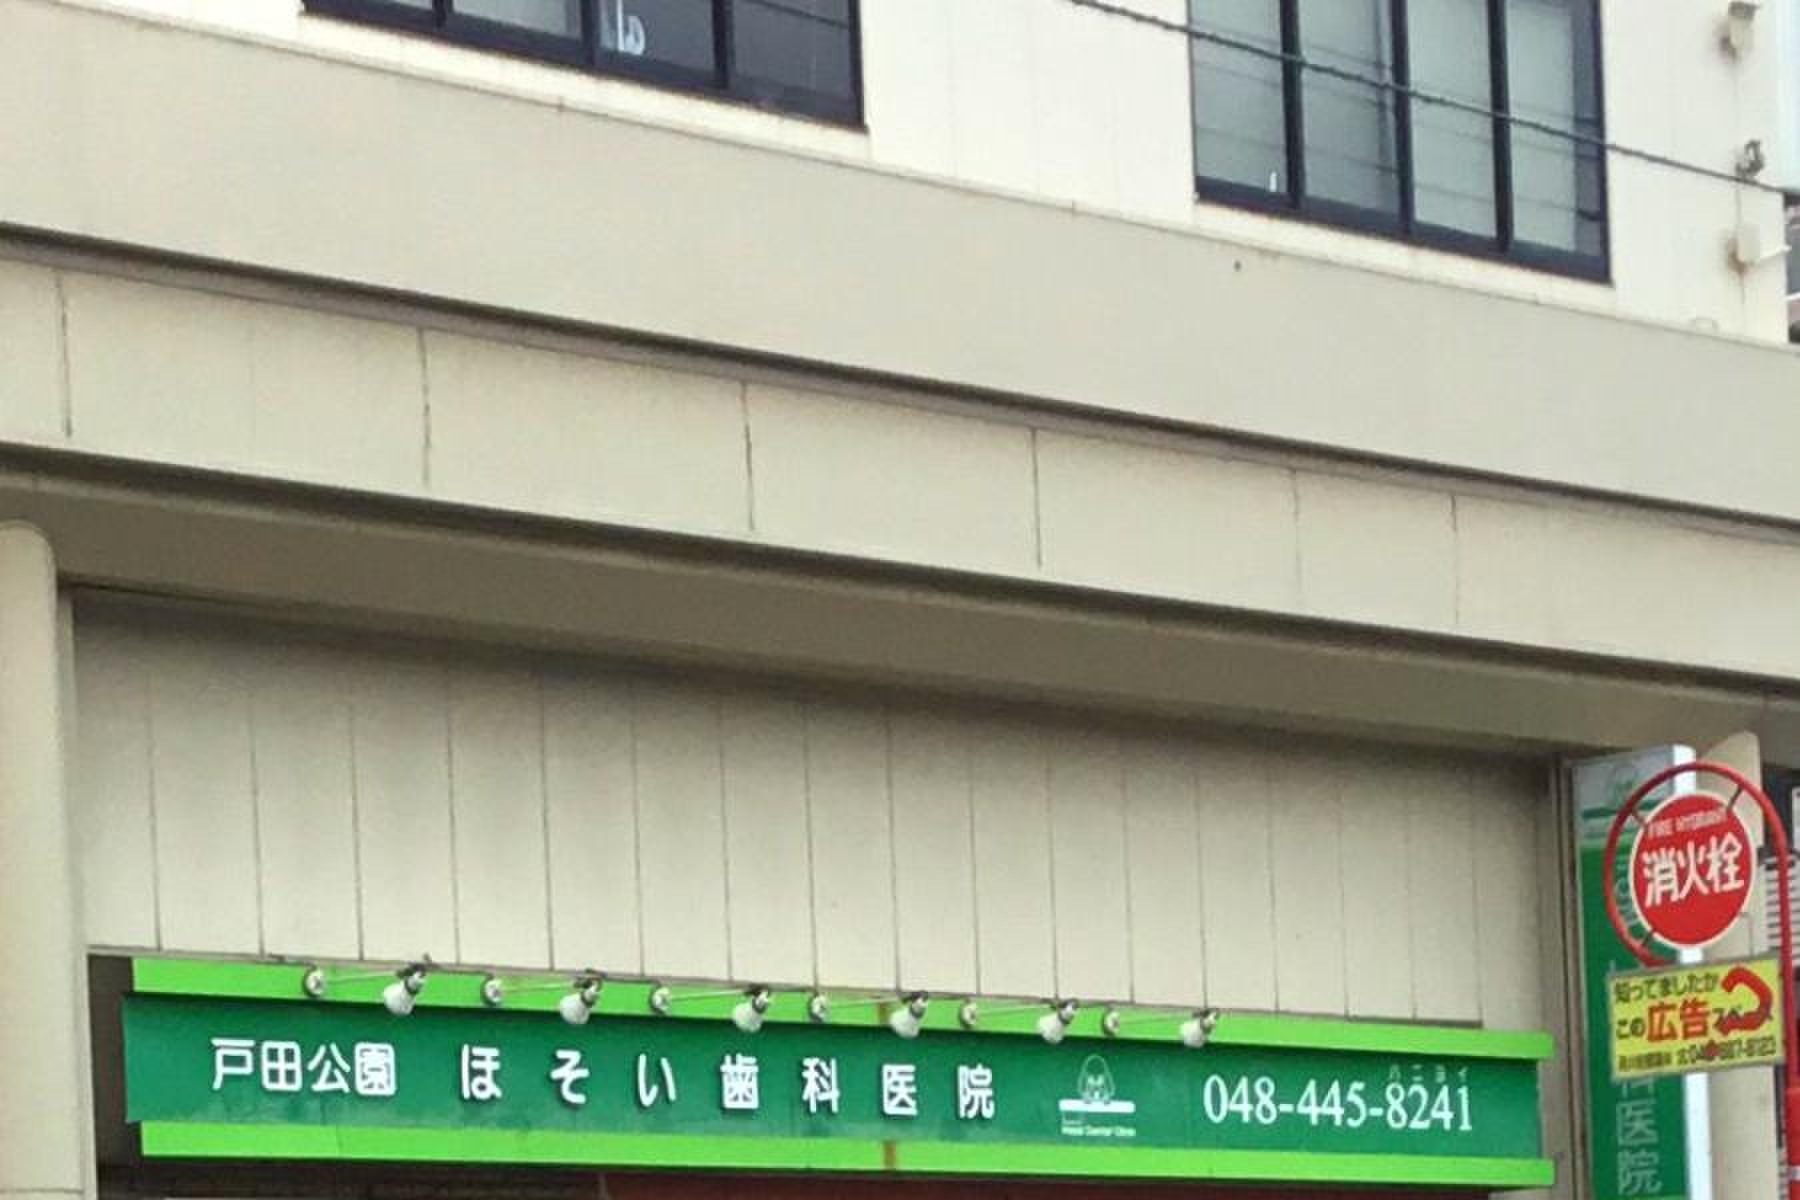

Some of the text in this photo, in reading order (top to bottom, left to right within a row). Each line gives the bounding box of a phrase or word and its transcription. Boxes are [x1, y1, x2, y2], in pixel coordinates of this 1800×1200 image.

[1642, 833, 1745, 908] 消火栓
[1616, 996, 1773, 1042] この広告スペ
[211, 1038, 995, 1118] 戸田公園 ほそい歯科医院
[1203, 1074, 1472, 1131] 048-445-8241
